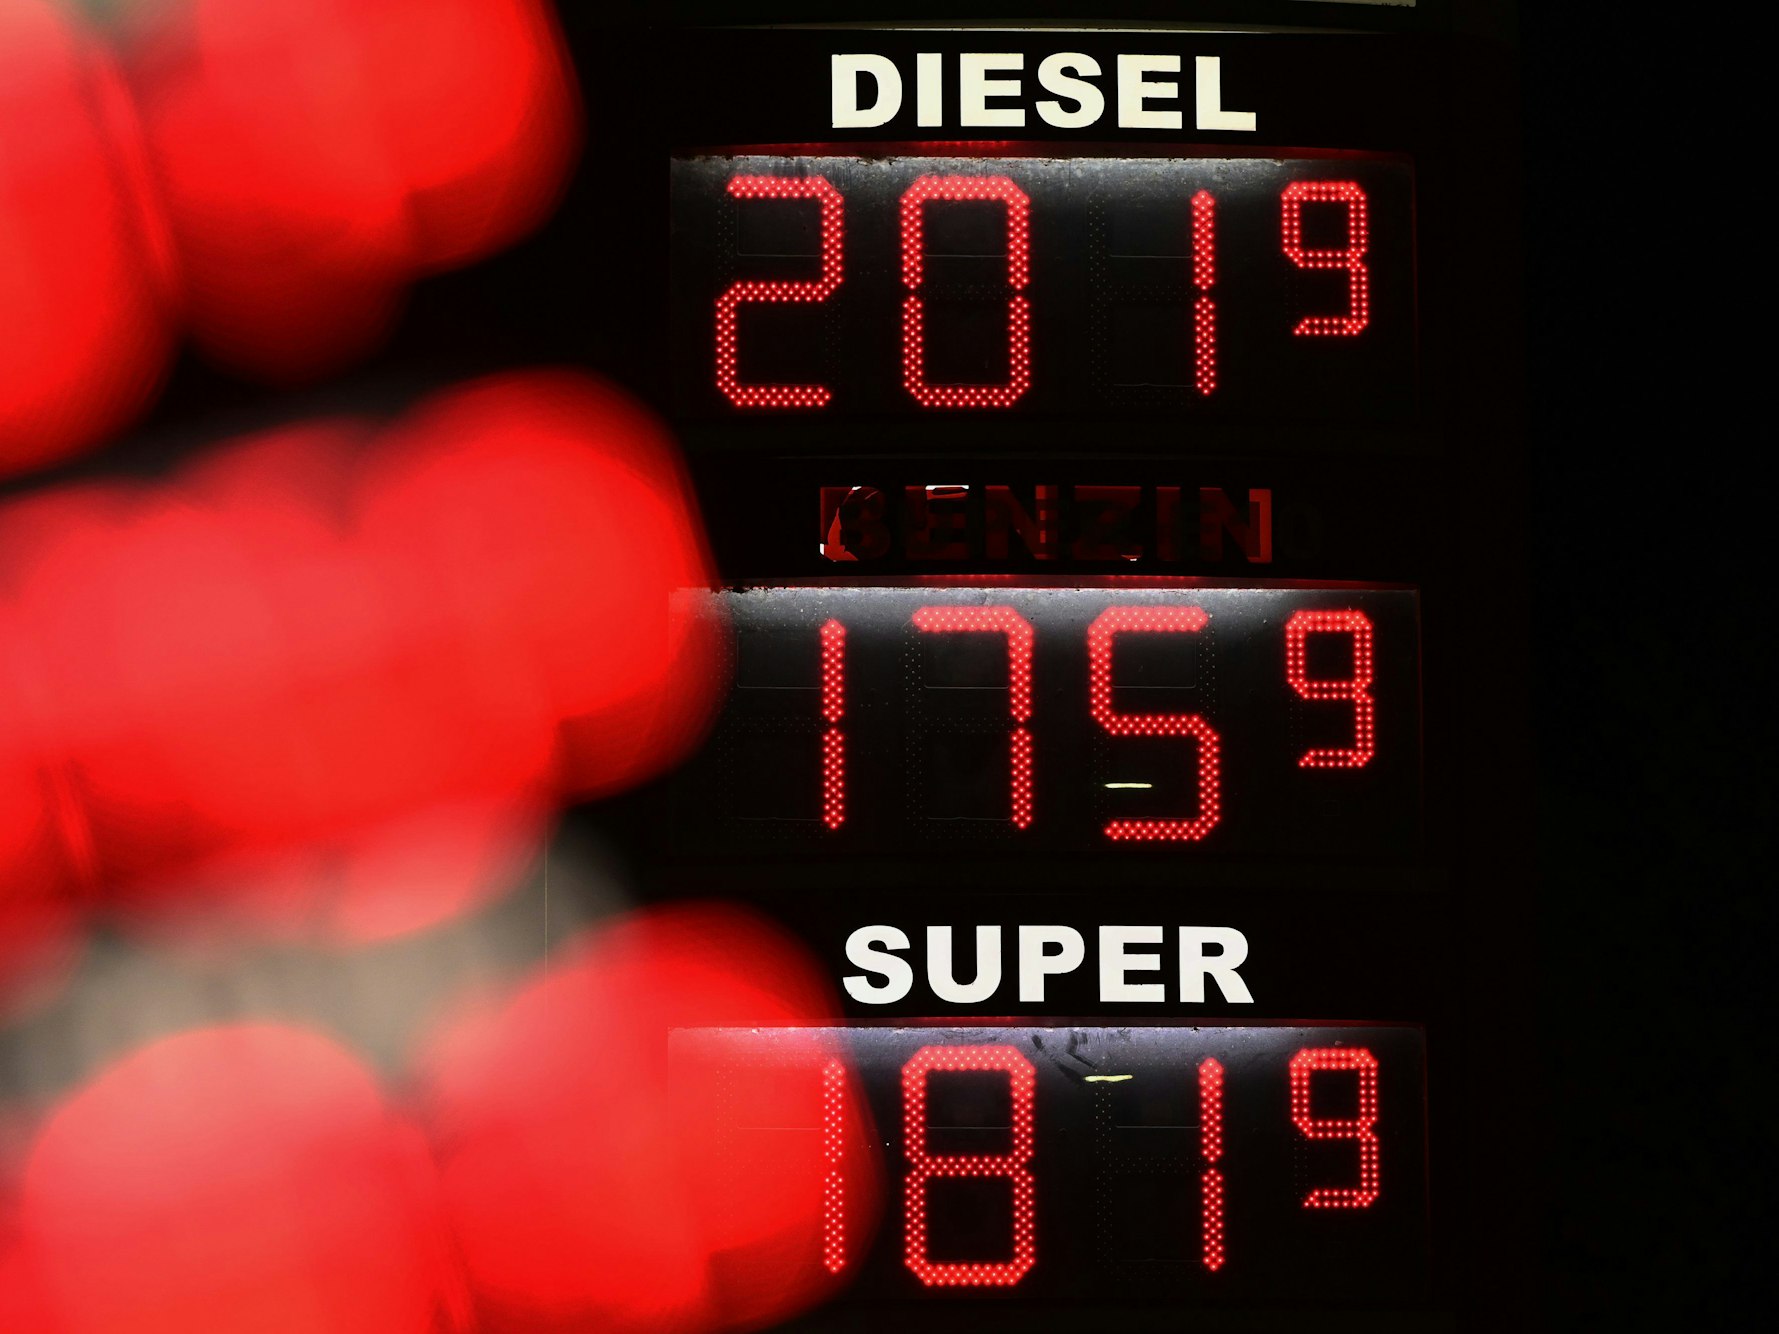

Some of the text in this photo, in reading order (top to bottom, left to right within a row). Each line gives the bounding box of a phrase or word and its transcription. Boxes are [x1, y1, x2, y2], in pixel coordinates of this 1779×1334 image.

[830, 53, 1257, 131] DIESEL
[819, 485, 1273, 562] BENZIN
[842, 924, 1254, 1005] SUPER
